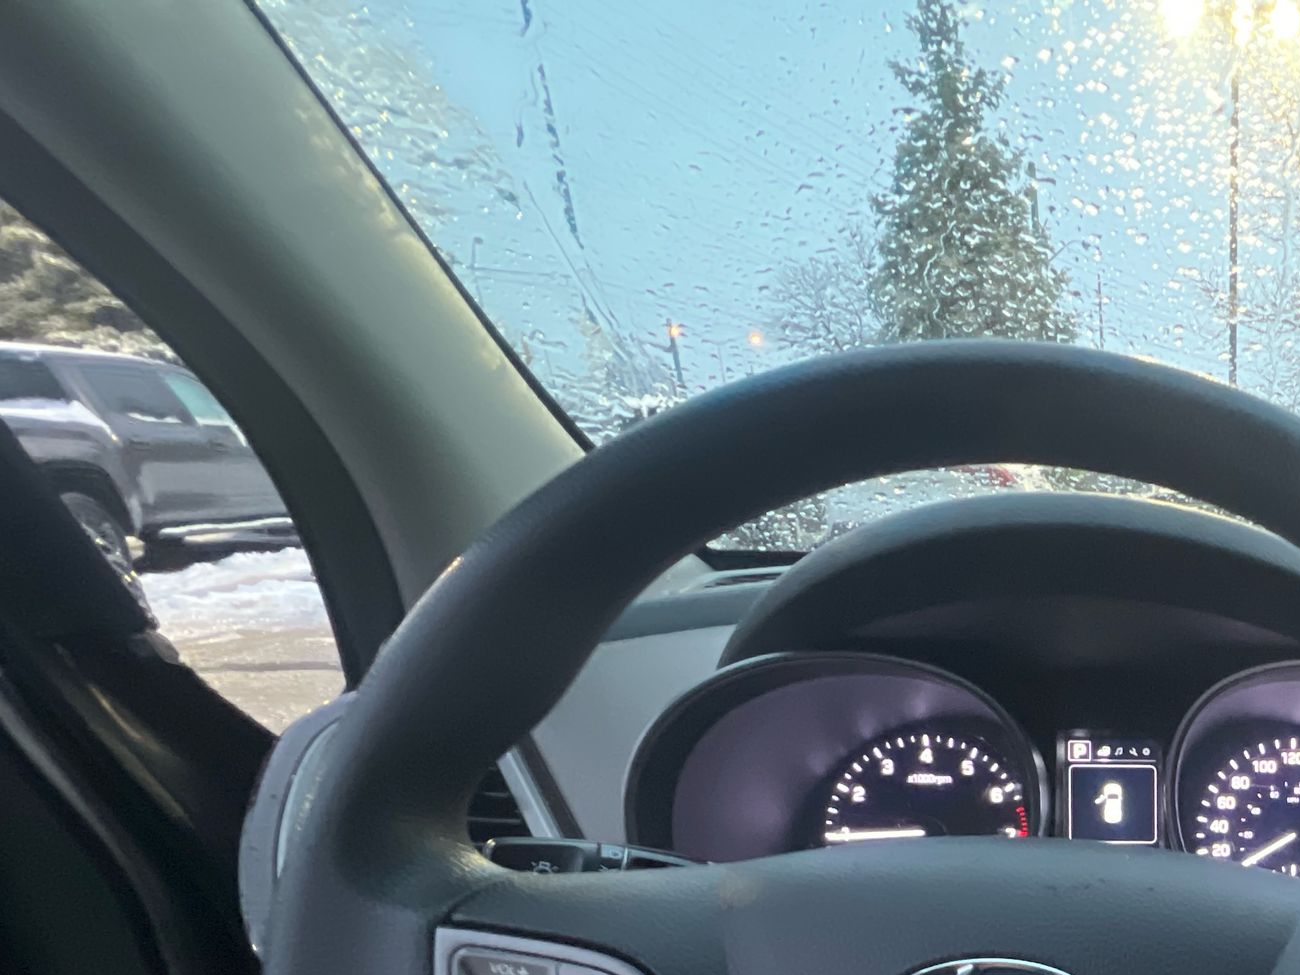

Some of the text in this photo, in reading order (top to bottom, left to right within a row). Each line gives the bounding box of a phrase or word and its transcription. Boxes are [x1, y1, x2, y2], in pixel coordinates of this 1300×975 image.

[919, 748, 933, 764] 4
[881, 758, 894, 775] 3
[961, 760, 975, 776] 5
[1252, 760, 1277, 773] 100
[1231, 776, 1250, 789] 80
[852, 786, 866, 802] 2
[989, 787, 1004, 803] 6
[1209, 819, 1229, 833] 40
[1211, 844, 1231, 857] 20
